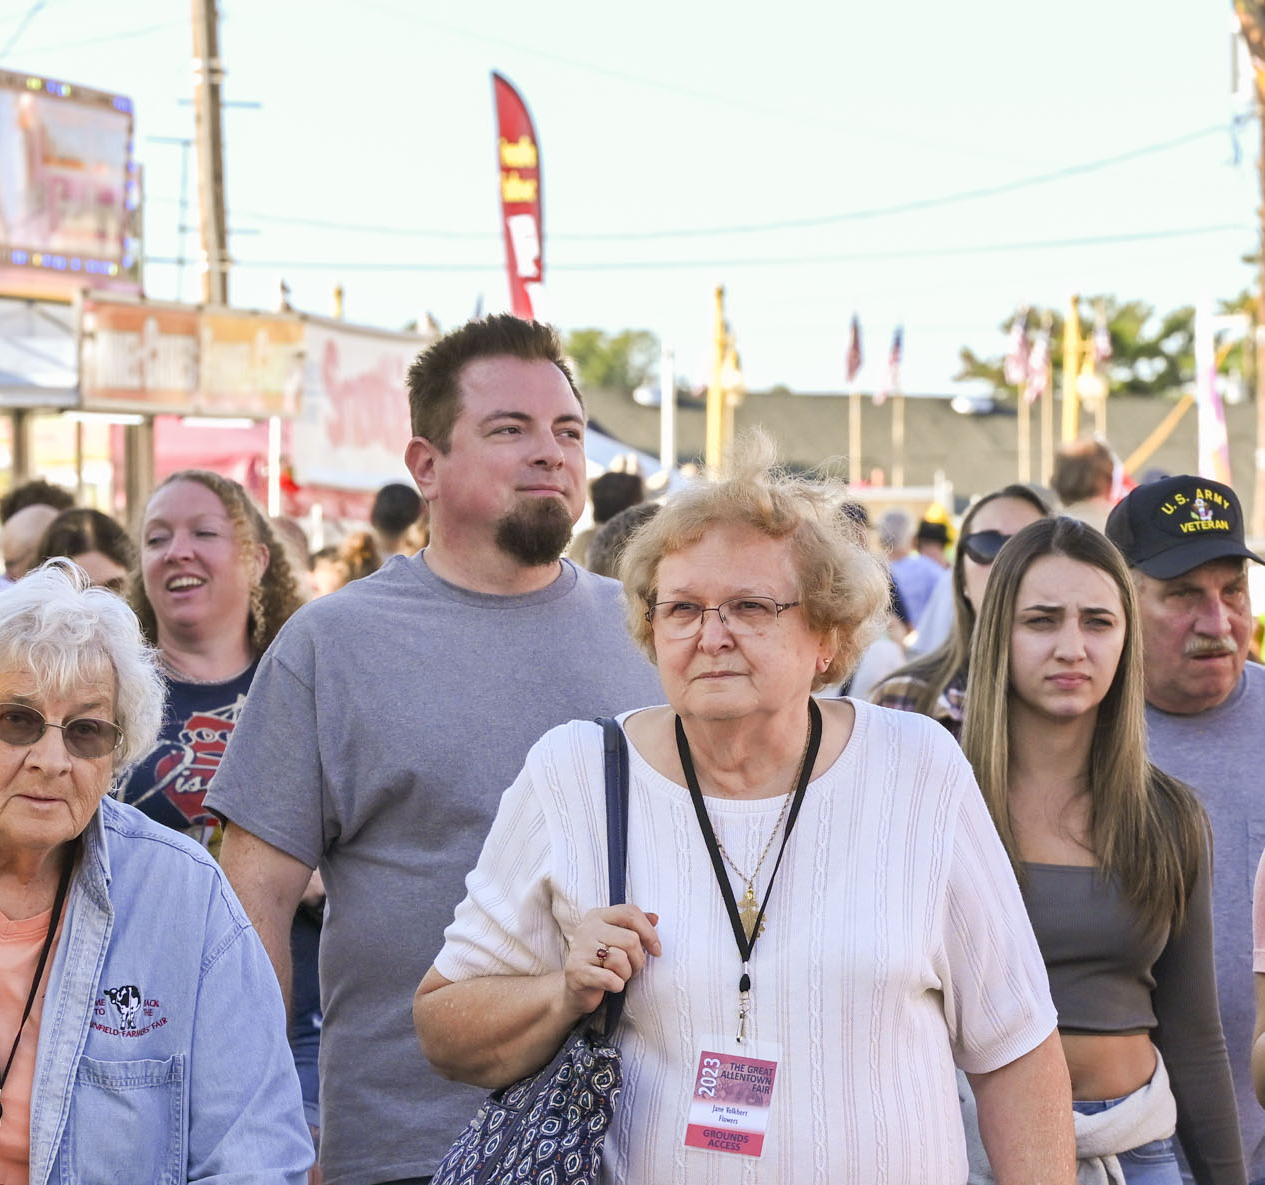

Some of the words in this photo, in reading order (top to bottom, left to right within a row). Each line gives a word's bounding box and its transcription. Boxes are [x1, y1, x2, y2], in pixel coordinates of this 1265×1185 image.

[1160, 493, 1190, 516] U.S.
[1196, 488, 1231, 510] ARMY
[1179, 519, 1230, 533] VETERAN
[94, 1008, 106, 1016] TO
[151, 1017, 168, 1030] FAIR
[730, 1062, 745, 1073] THE
[747, 1065, 774, 1076] GREAT
[698, 1058, 721, 1097] 2023
[720, 1070, 772, 1085] ALLENTOWN
[752, 1084, 770, 1094] FAIR
[712, 1104, 724, 1113] Jane
[703, 1129, 749, 1144] GROUNDS
[707, 1139, 741, 1151] ACCESS
